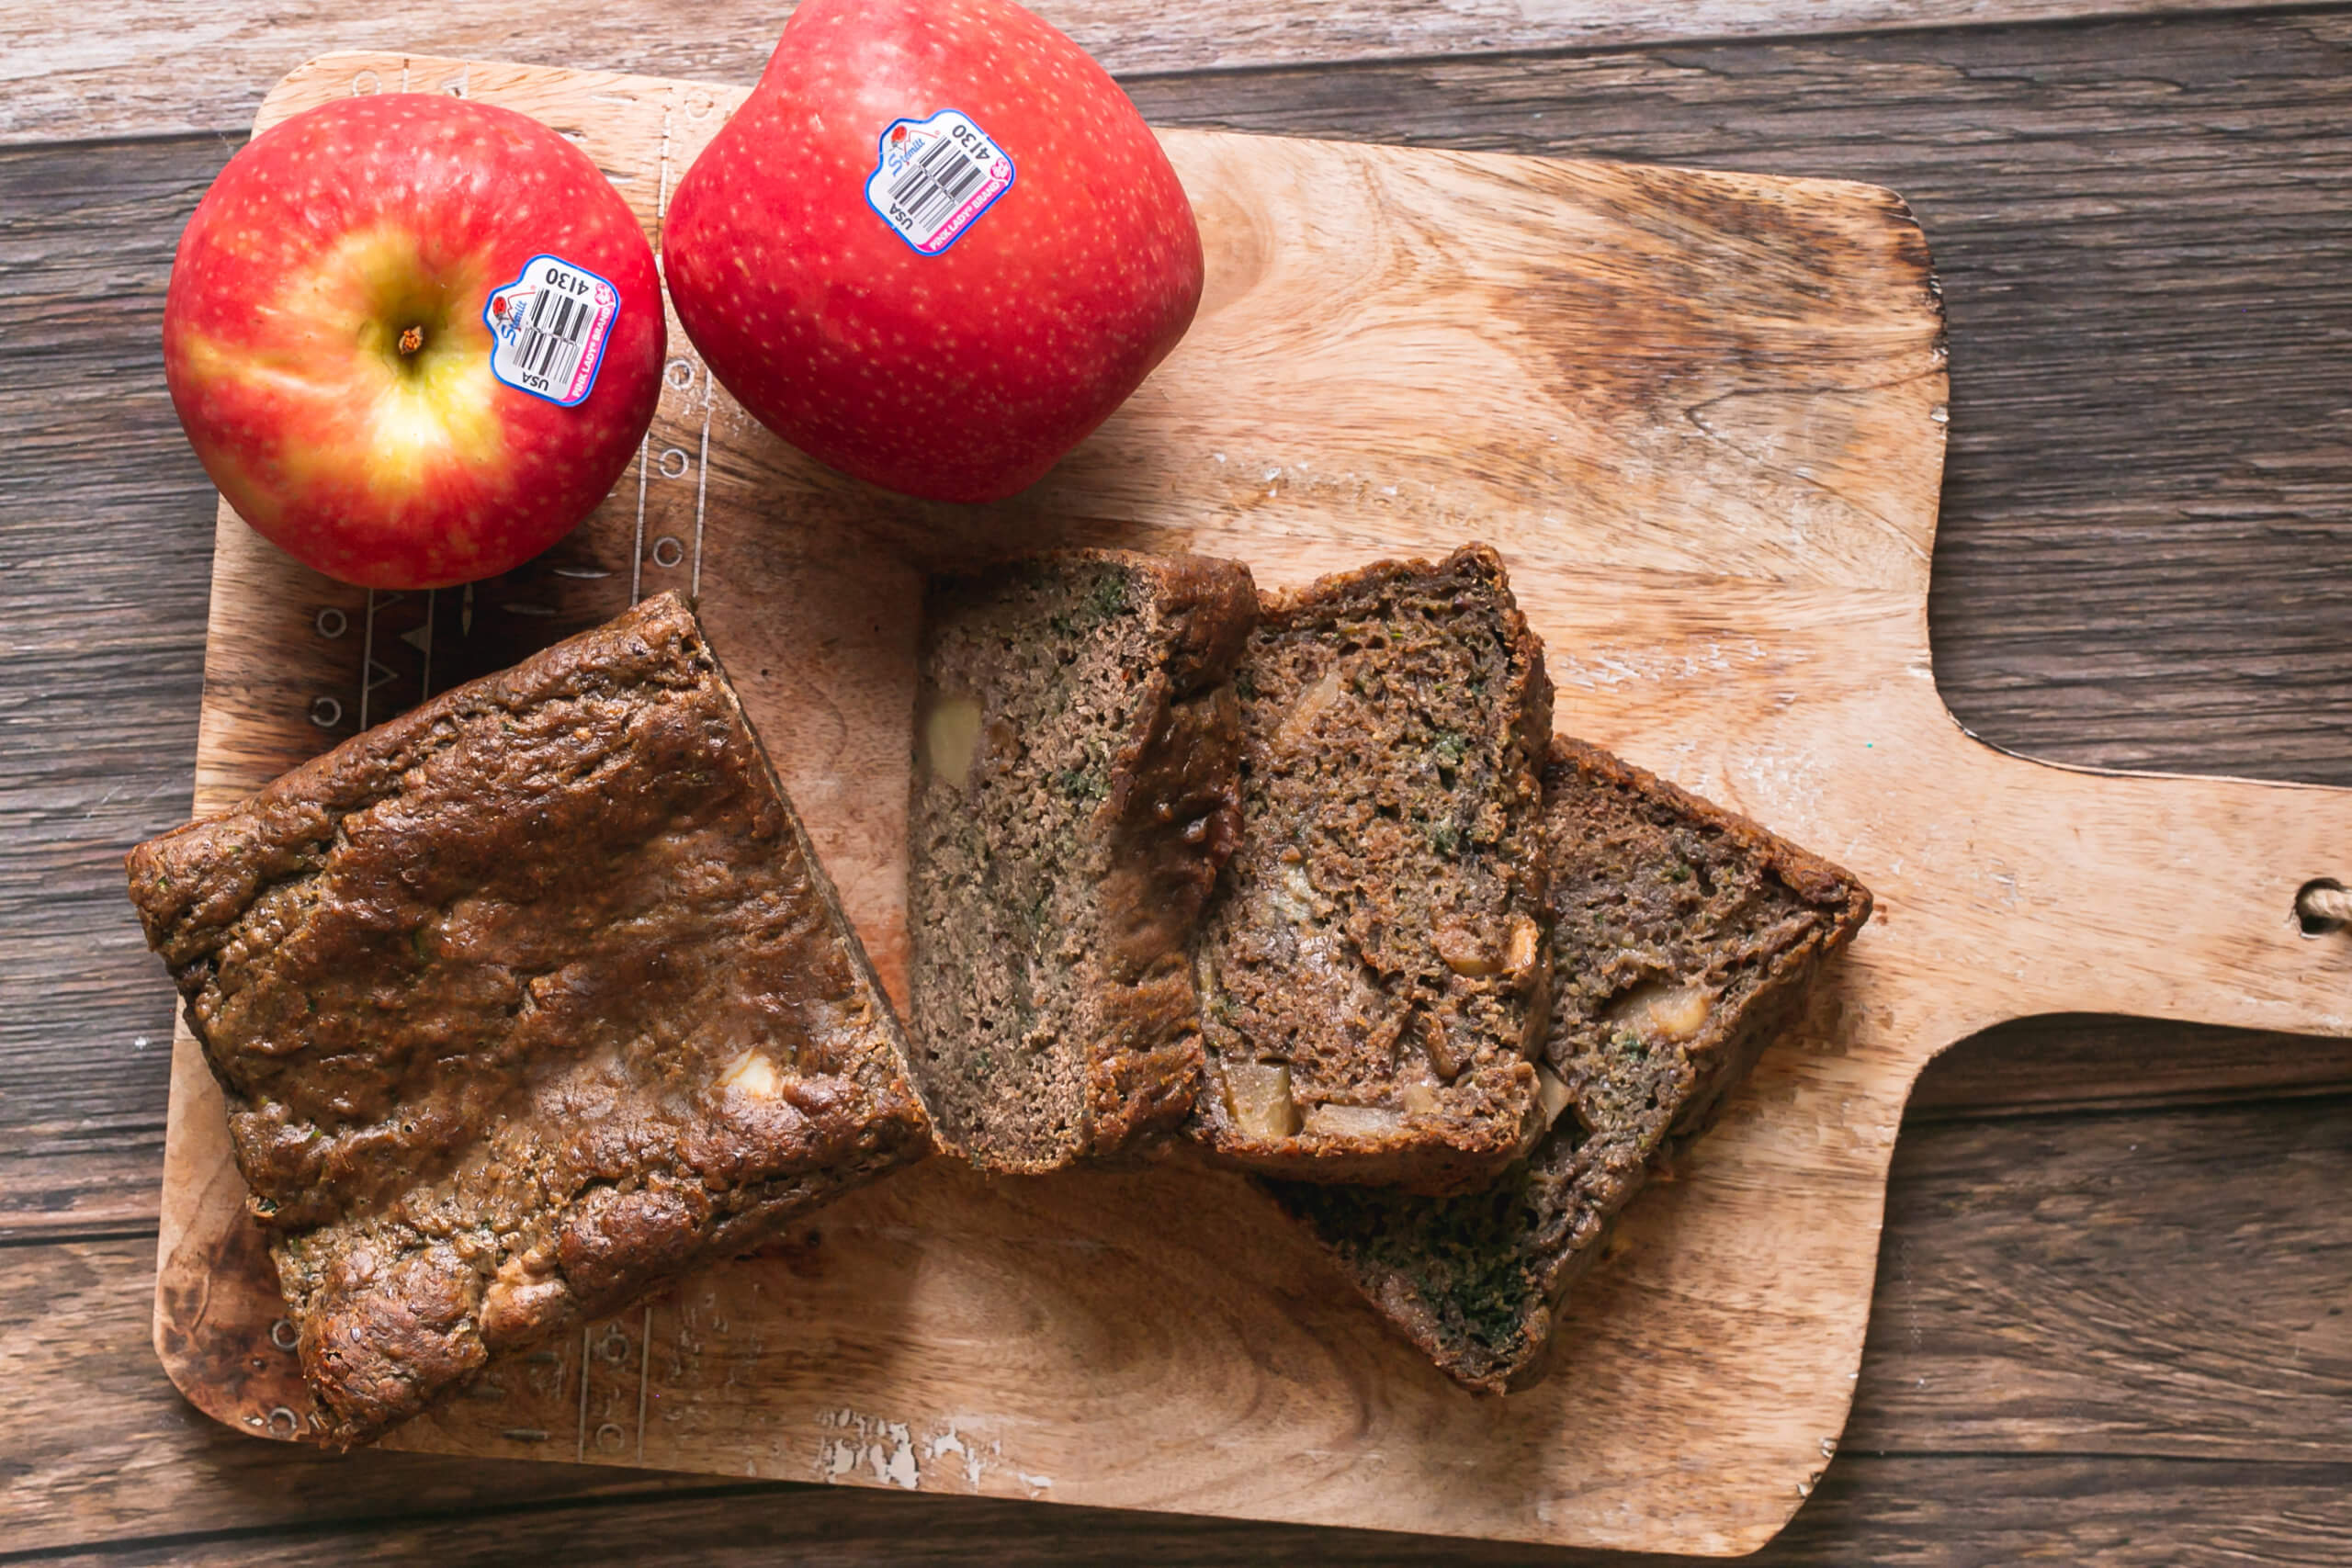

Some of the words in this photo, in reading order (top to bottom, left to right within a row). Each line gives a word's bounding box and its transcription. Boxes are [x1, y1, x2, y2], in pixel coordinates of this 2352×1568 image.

[952, 124, 990, 160] 4130
[888, 203, 913, 231] USA
[929, 229, 952, 250] PINK
[971, 181, 1001, 209] BRAND
[546, 267, 589, 296] 4130
[592, 307, 611, 341] BRAND
[522, 371, 549, 391] USA
